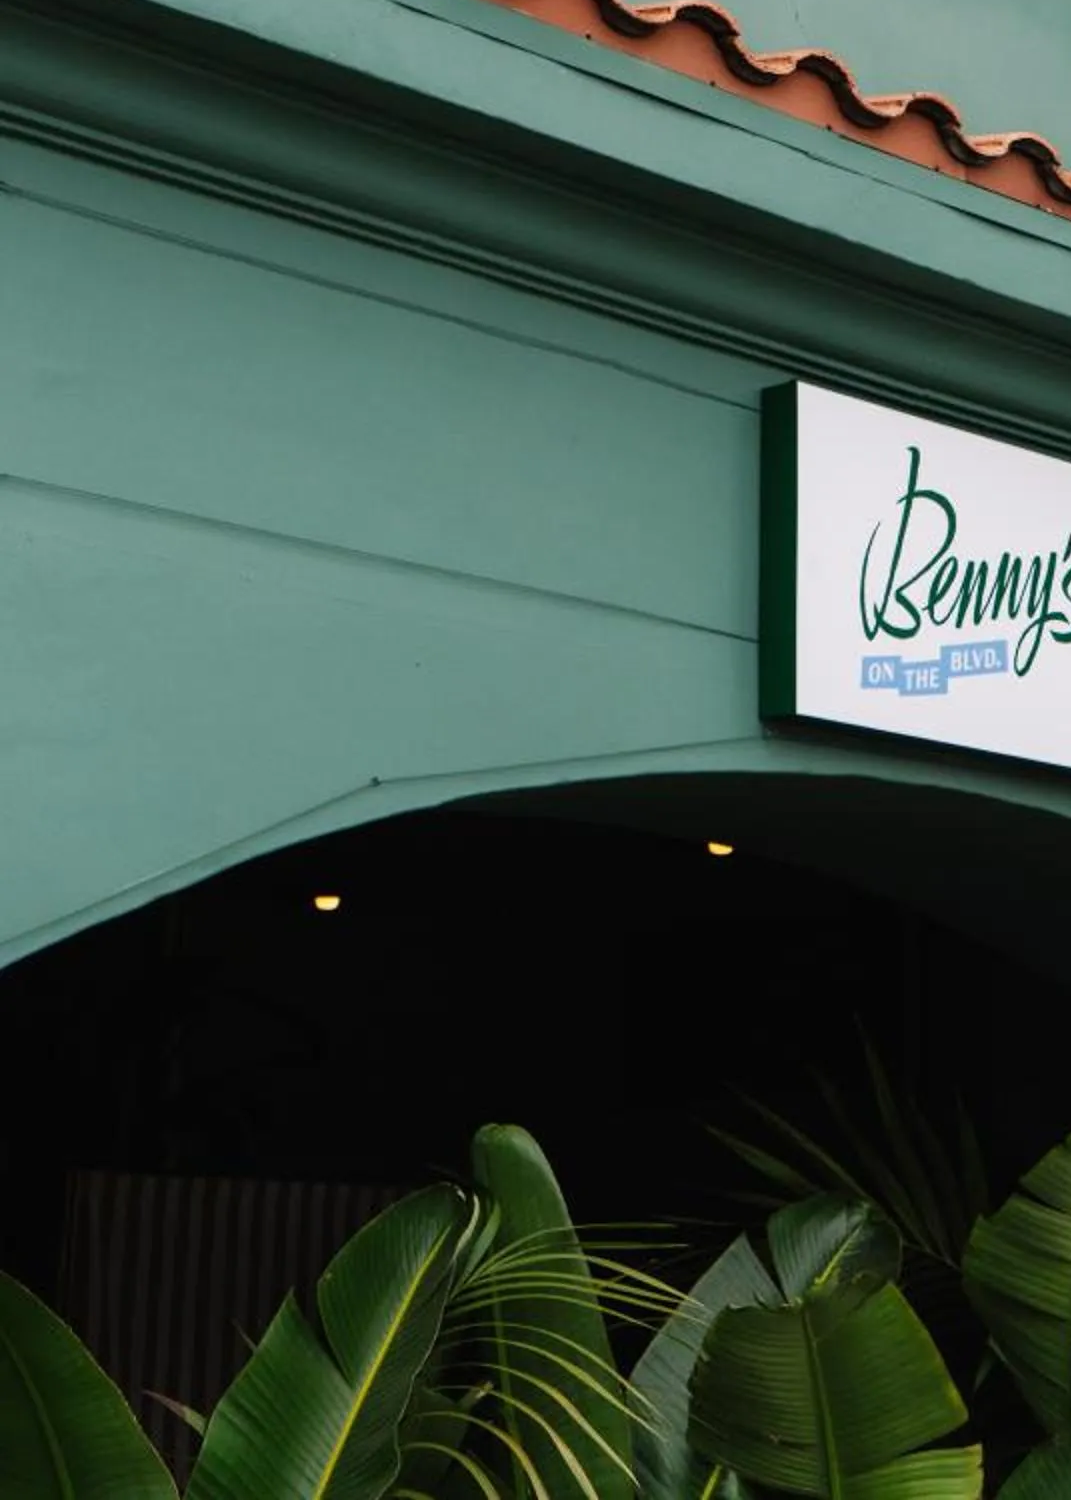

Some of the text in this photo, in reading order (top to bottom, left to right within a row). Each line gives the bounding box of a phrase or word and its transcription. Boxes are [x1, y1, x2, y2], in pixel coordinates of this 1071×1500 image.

[868, 647, 1003, 691] ON THE BLVD.
